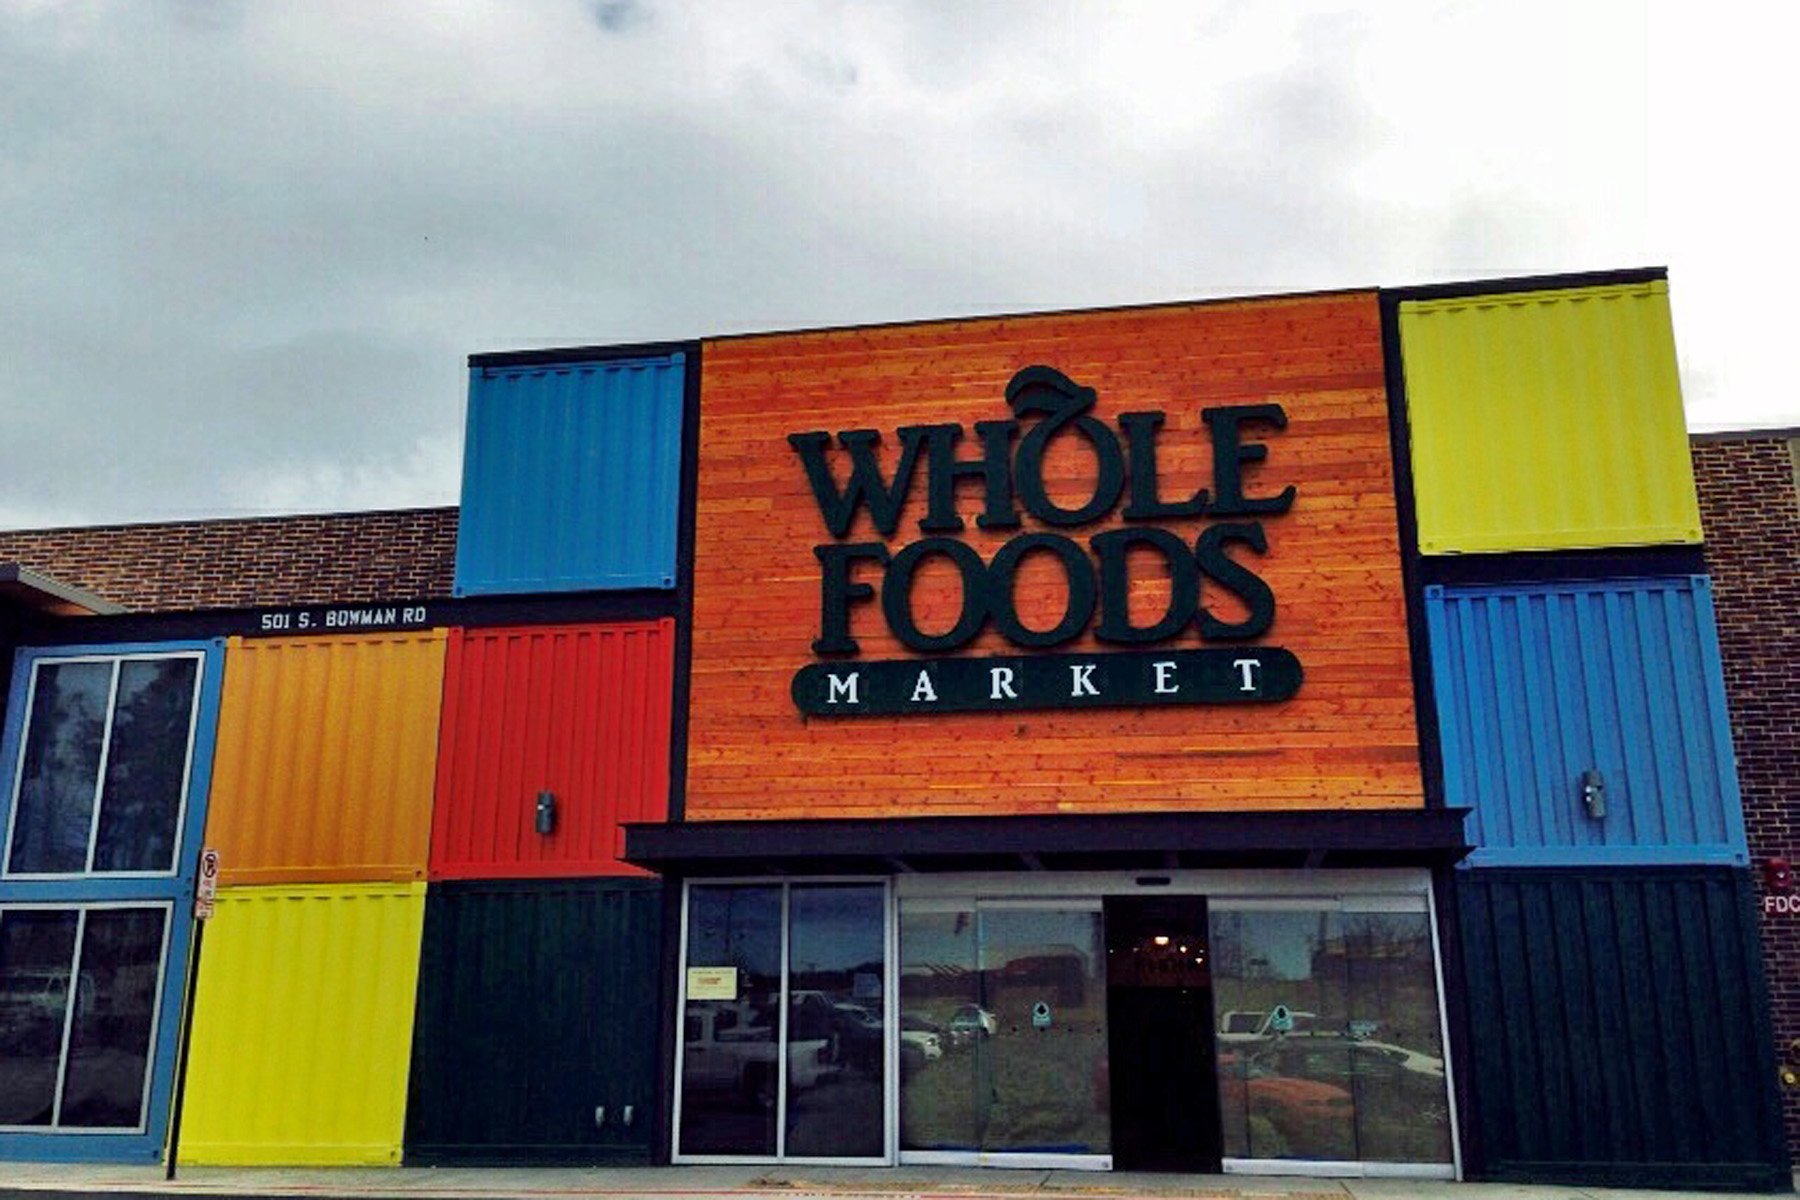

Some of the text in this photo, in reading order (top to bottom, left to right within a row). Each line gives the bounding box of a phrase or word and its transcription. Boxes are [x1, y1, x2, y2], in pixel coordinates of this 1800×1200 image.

[787, 366, 1297, 540] WHOLE
[811, 522, 1277, 655] FOODS
[261, 606, 427, 630] 501 S. BOWMAN RD
[826, 659, 1262, 704] MARKET
[1765, 894, 1800, 913] FDC
